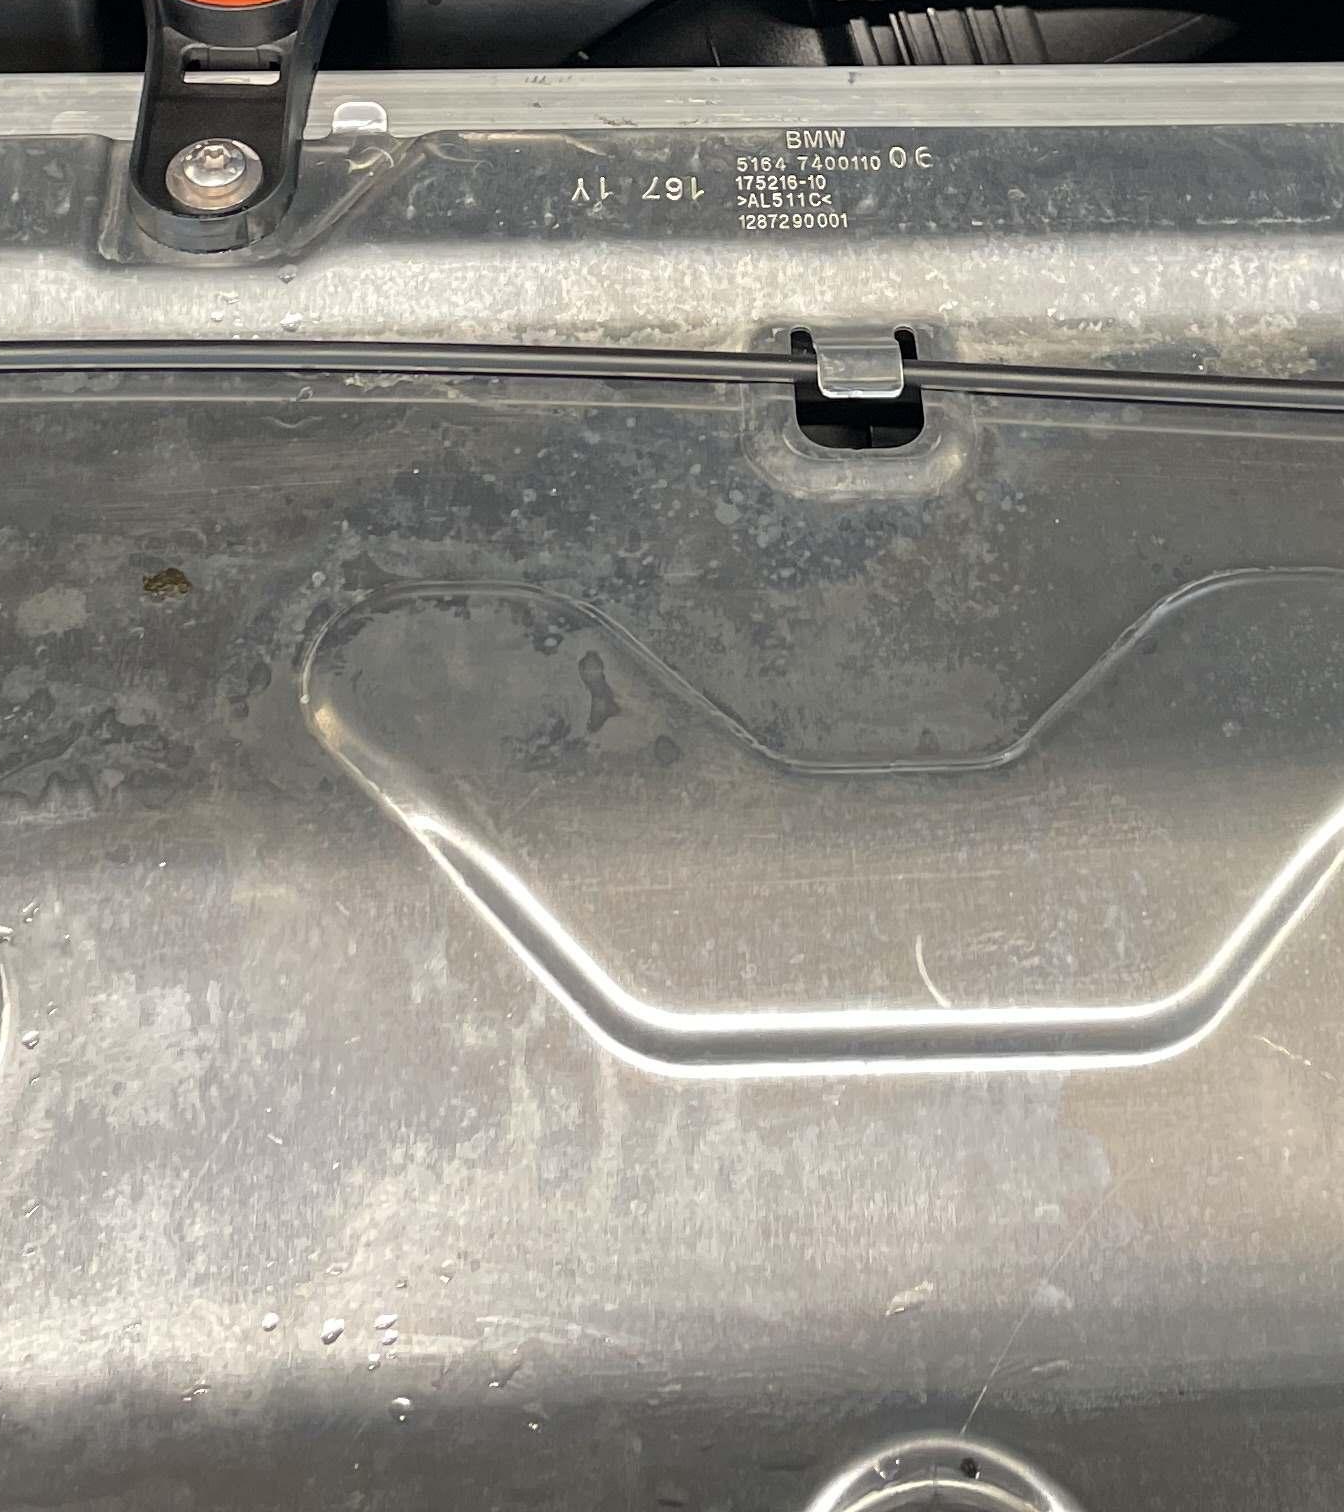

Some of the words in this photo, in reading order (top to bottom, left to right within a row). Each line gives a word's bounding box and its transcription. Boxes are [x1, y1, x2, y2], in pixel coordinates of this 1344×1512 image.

[785, 130, 846, 150] BMW
[736, 156, 786, 173] 5164
[797, 155, 882, 172] 7400110
[641, 176, 705, 201] 167
[736, 174, 827, 191] 175216-10
[736, 192, 833, 208] >AL511C<
[738, 212, 849, 230] 1287290001
